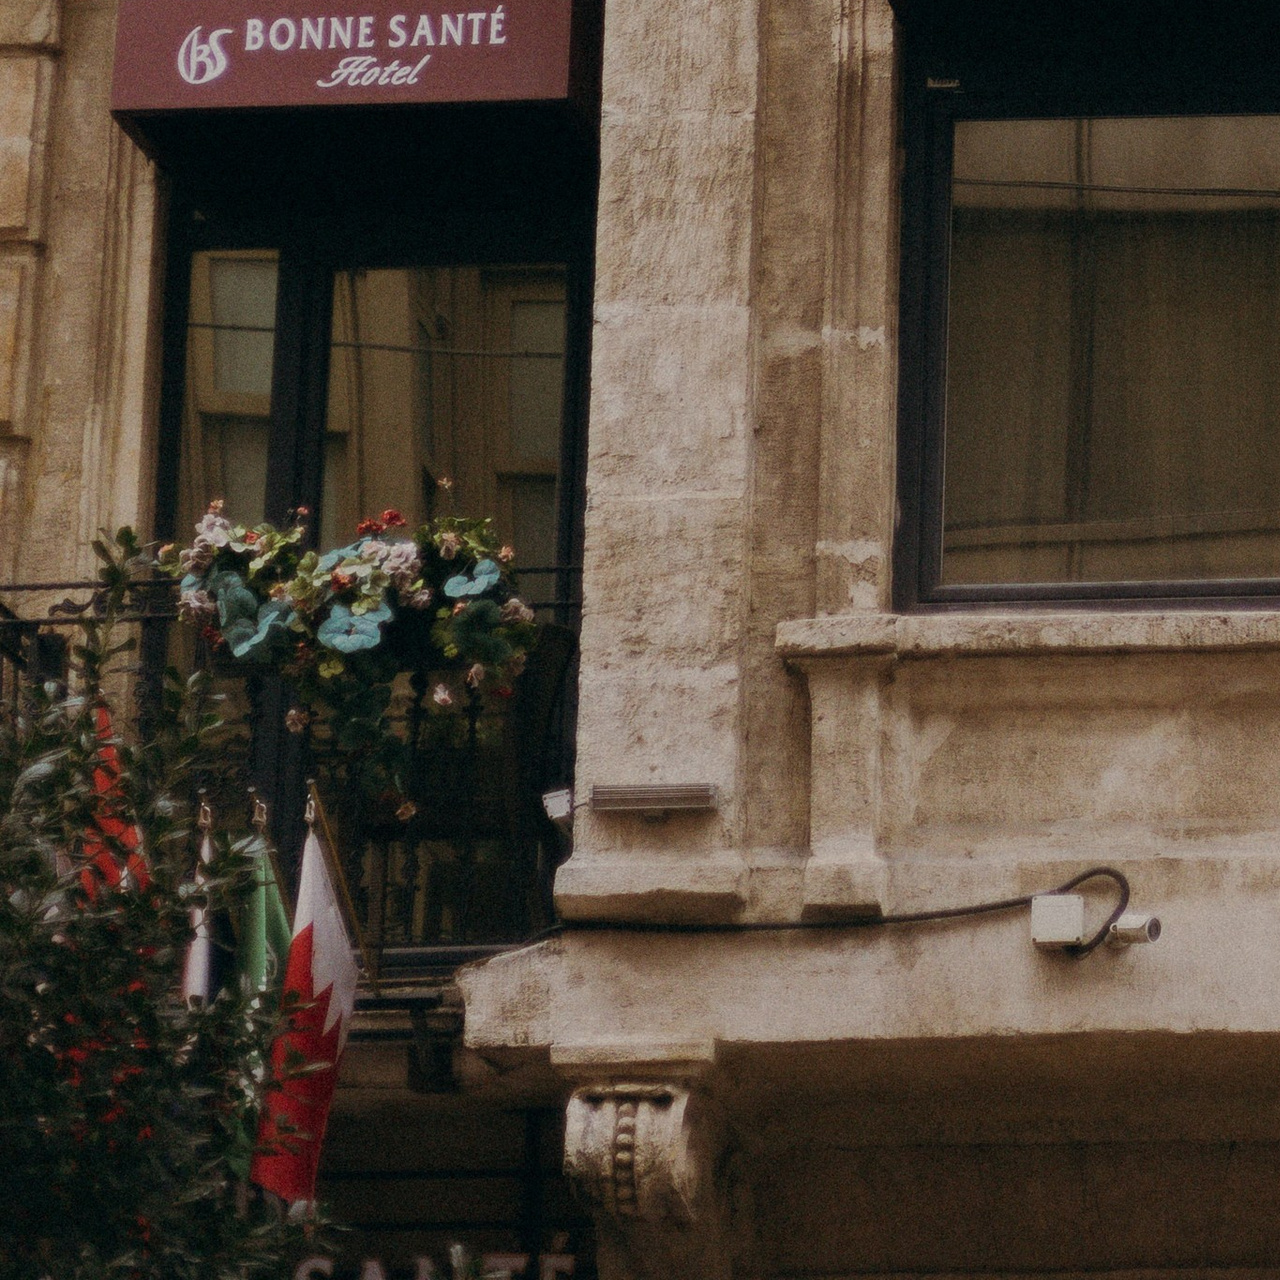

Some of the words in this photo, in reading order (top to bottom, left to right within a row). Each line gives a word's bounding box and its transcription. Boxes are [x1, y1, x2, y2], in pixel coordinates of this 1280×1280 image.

[244, 15, 375, 51] BONNE
[388, 4, 507, 48] SANTÉ
[316, 54, 432, 88] Hotel
